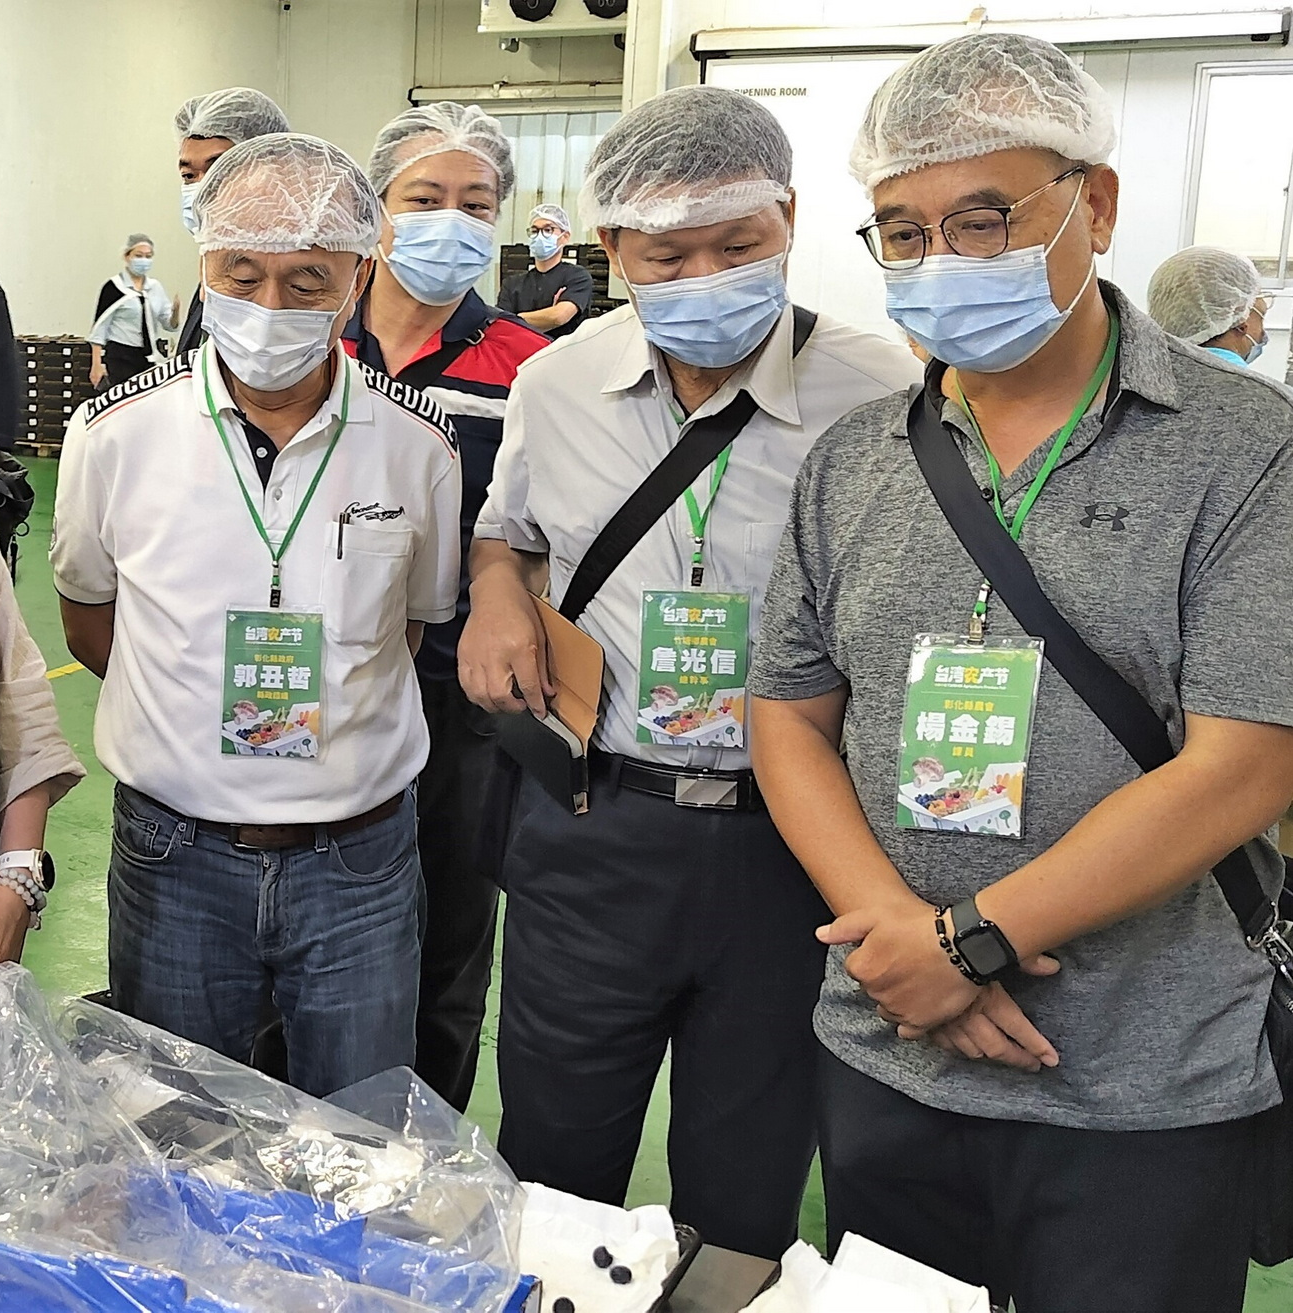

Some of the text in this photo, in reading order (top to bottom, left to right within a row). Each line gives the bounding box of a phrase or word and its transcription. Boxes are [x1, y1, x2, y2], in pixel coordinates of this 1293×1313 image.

[735, 87, 807, 97] PENING ROOM
[361, 362, 457, 443] ROCODILE
[650, 646, 738, 675] 詹光信
[233, 663, 312, 690] 郭丑哲
[934, 664, 1011, 686] 台湾农产节
[915, 711, 1017, 747] 楊金錫
